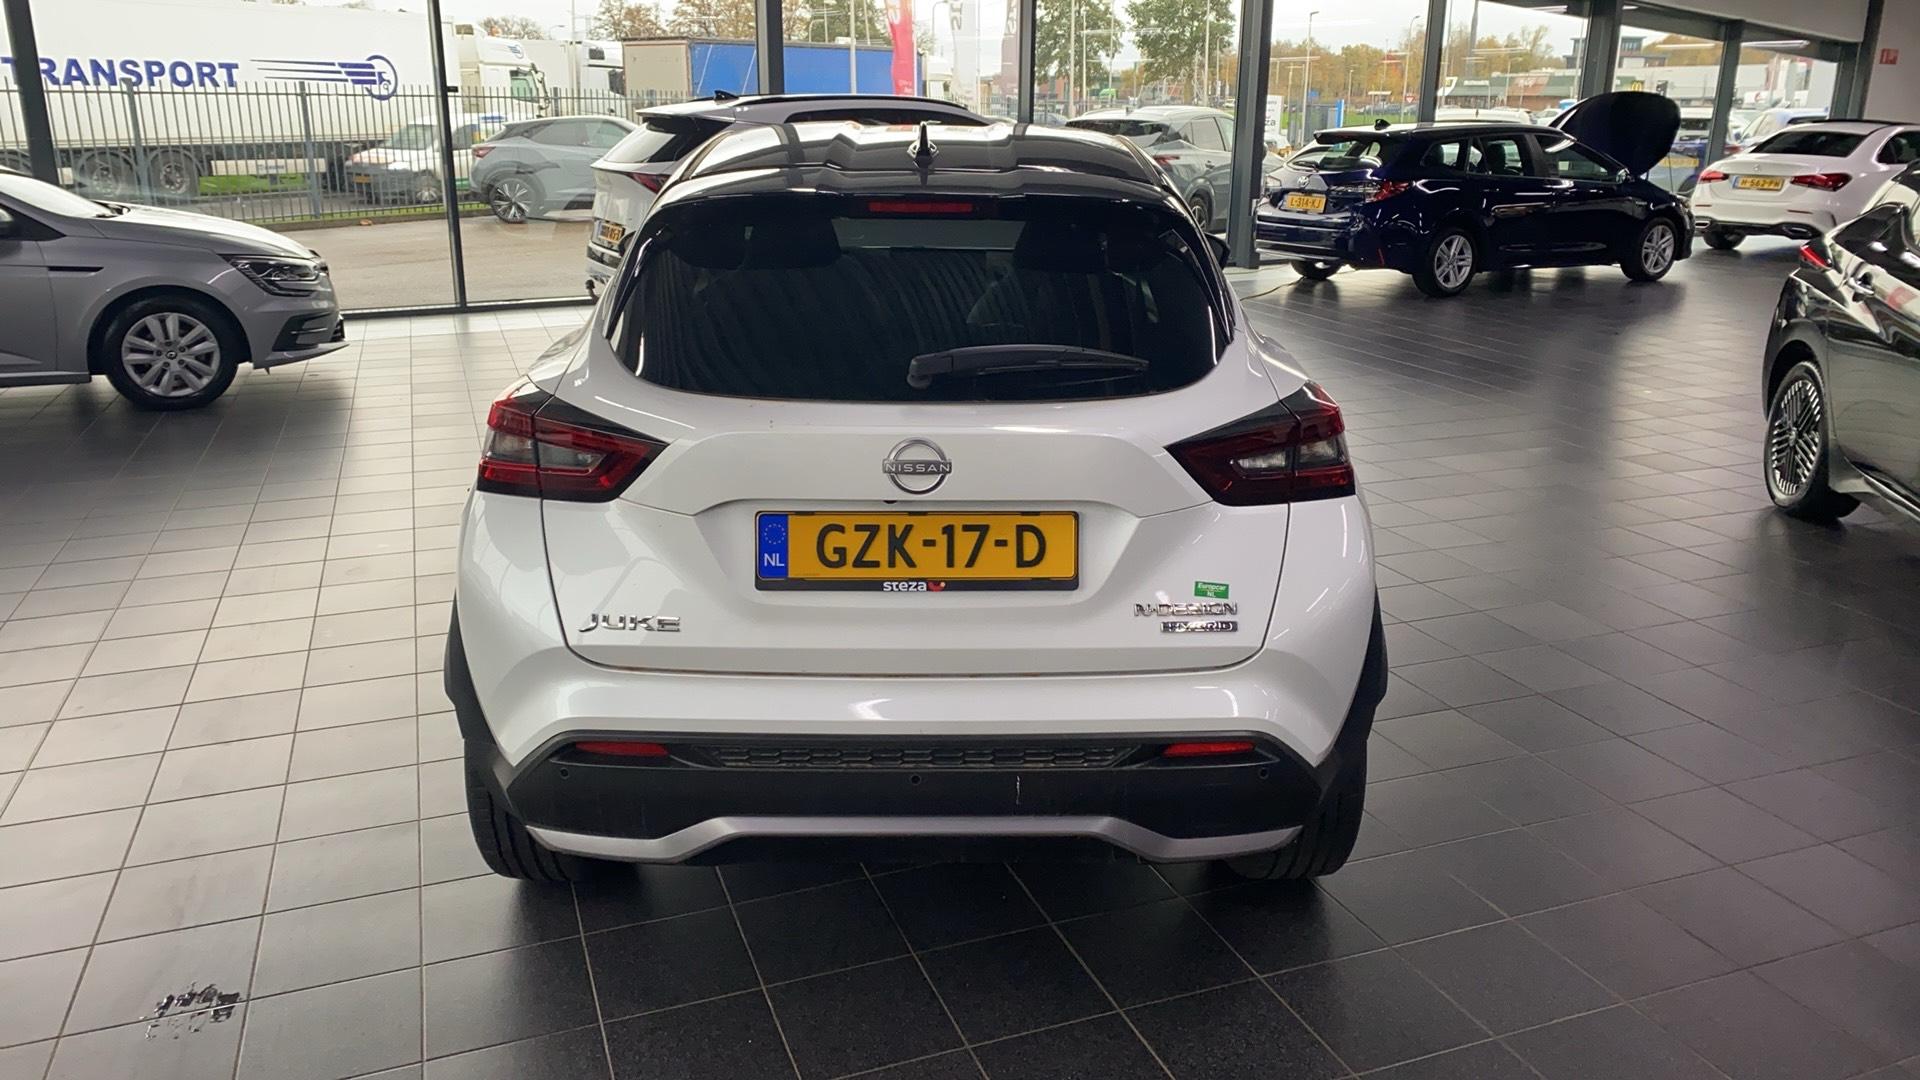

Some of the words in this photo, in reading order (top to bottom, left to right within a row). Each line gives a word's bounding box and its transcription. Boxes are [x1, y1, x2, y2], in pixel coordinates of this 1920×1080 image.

[885, 462, 951, 472] NISSAN
[815, 522, 1047, 569] GZK-17-D
[763, 553, 785, 567] NL
[883, 579, 927, 592] steza
[1134, 601, 1238, 617] N-DESIGN
[578, 613, 681, 633] JUKE
